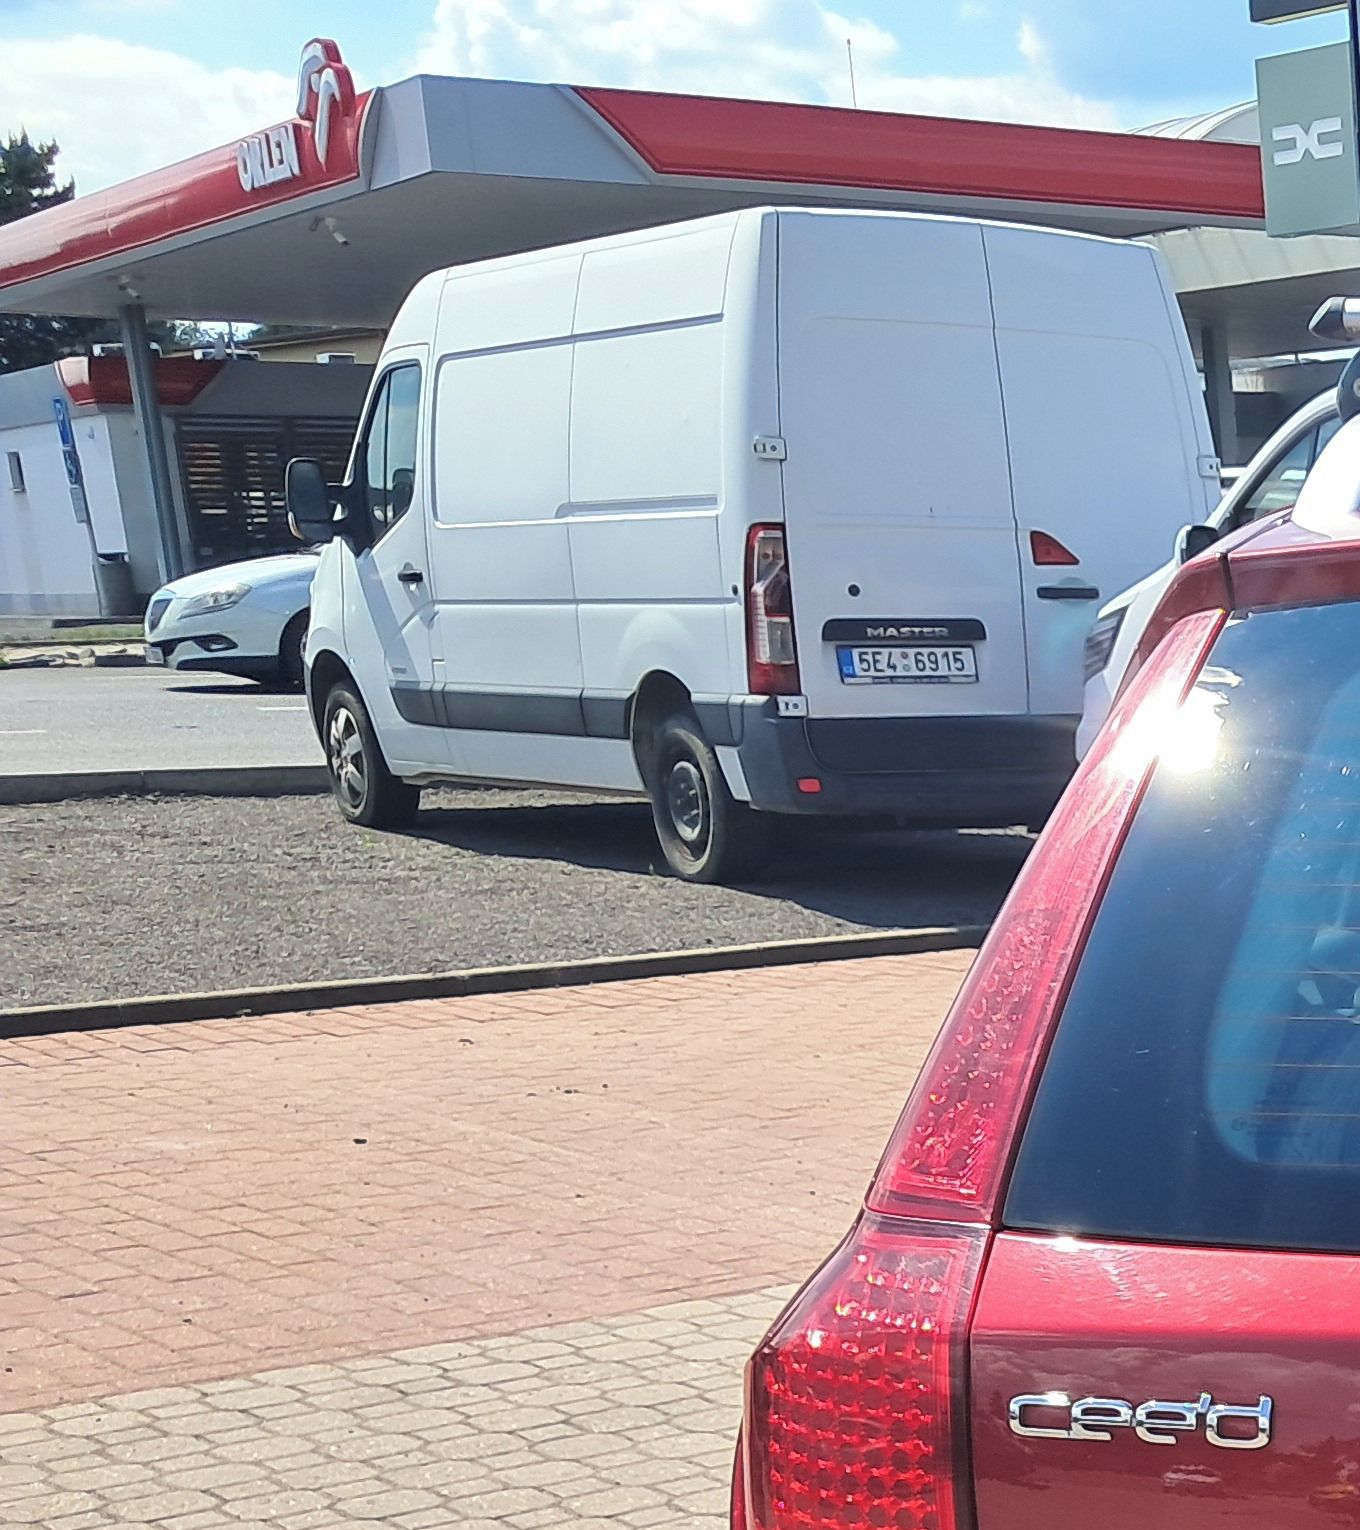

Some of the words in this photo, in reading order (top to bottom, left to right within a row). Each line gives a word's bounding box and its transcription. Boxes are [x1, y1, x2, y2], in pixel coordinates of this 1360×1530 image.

[236, 122, 300, 192] ORLEN
[866, 627, 950, 637] MASTER
[858, 651, 897, 673] 5E4
[914, 651, 966, 672] 6915
